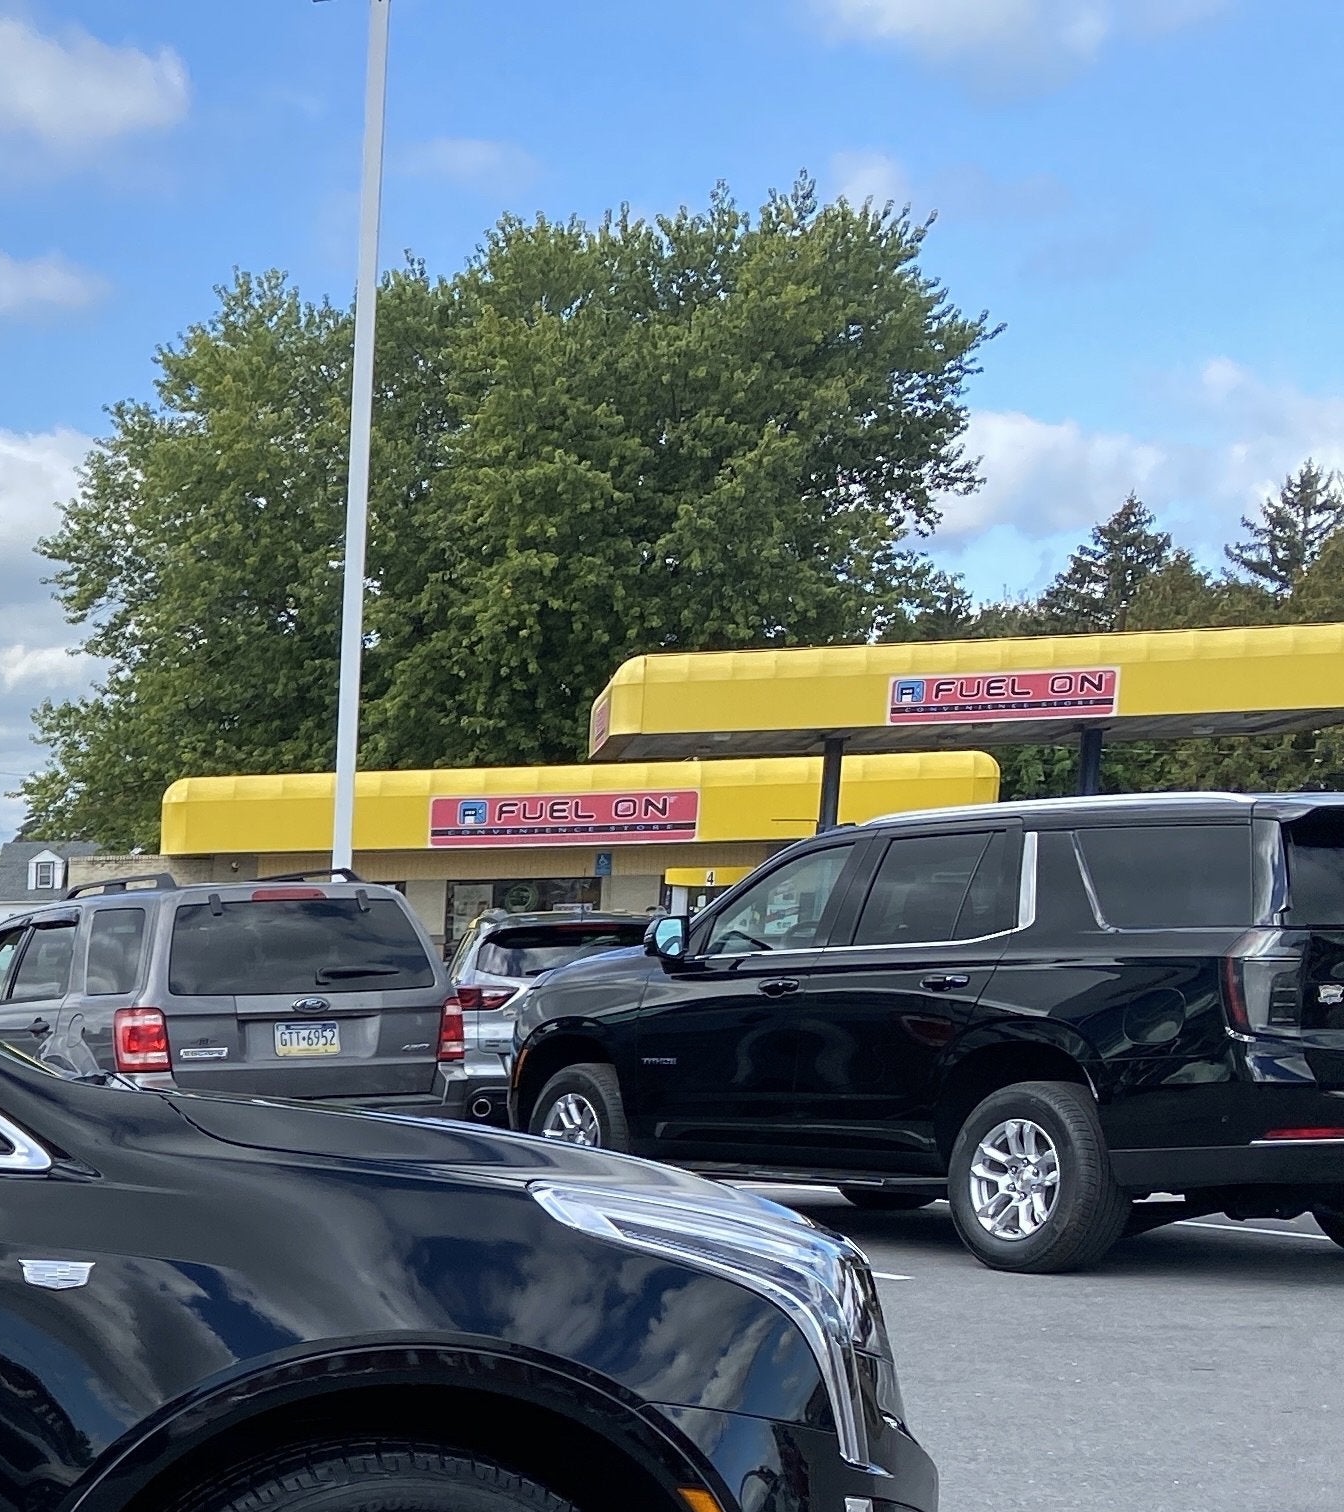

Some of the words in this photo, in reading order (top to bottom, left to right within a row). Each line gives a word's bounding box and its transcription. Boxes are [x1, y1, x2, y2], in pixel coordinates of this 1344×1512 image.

[933, 677, 1032, 700] FUEL
[1049, 672, 1104, 695] ON
[904, 702, 1029, 713] CONVENIENCE
[1040, 699, 1097, 708] STORE
[496, 799, 595, 823] FUEL
[614, 796, 669, 818] ON
[447, 825, 595, 836] CONVENIENCE
[609, 823, 674, 831] STORE
[707, 872, 714, 885] 4
